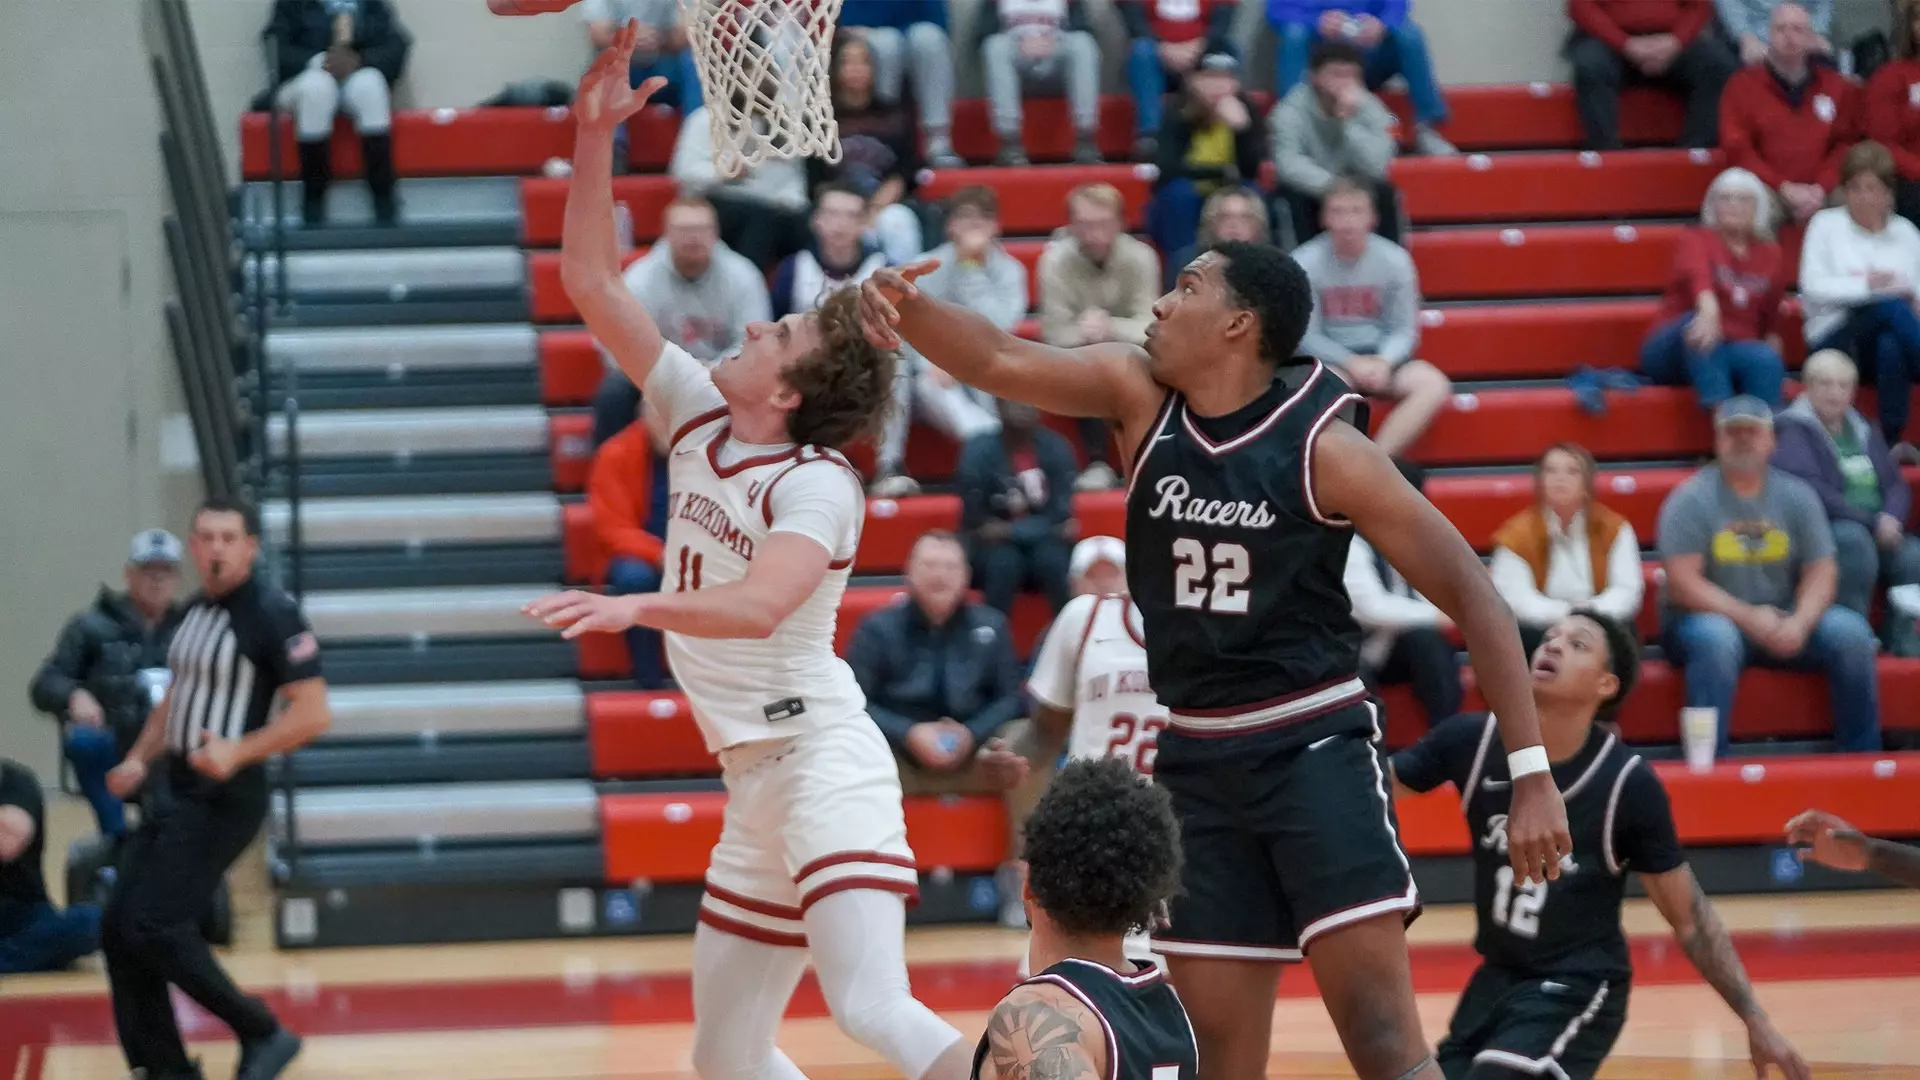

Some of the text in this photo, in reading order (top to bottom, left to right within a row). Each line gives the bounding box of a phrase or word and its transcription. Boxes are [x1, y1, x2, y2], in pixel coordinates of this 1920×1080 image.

[680, 492, 753, 561] KOKOMO
[1149, 475, 1276, 528] Racers
[676, 544, 704, 593] 11
[1172, 537, 1251, 613] 22
[1108, 712, 1168, 775] 22
[1492, 865, 1549, 939] 12
